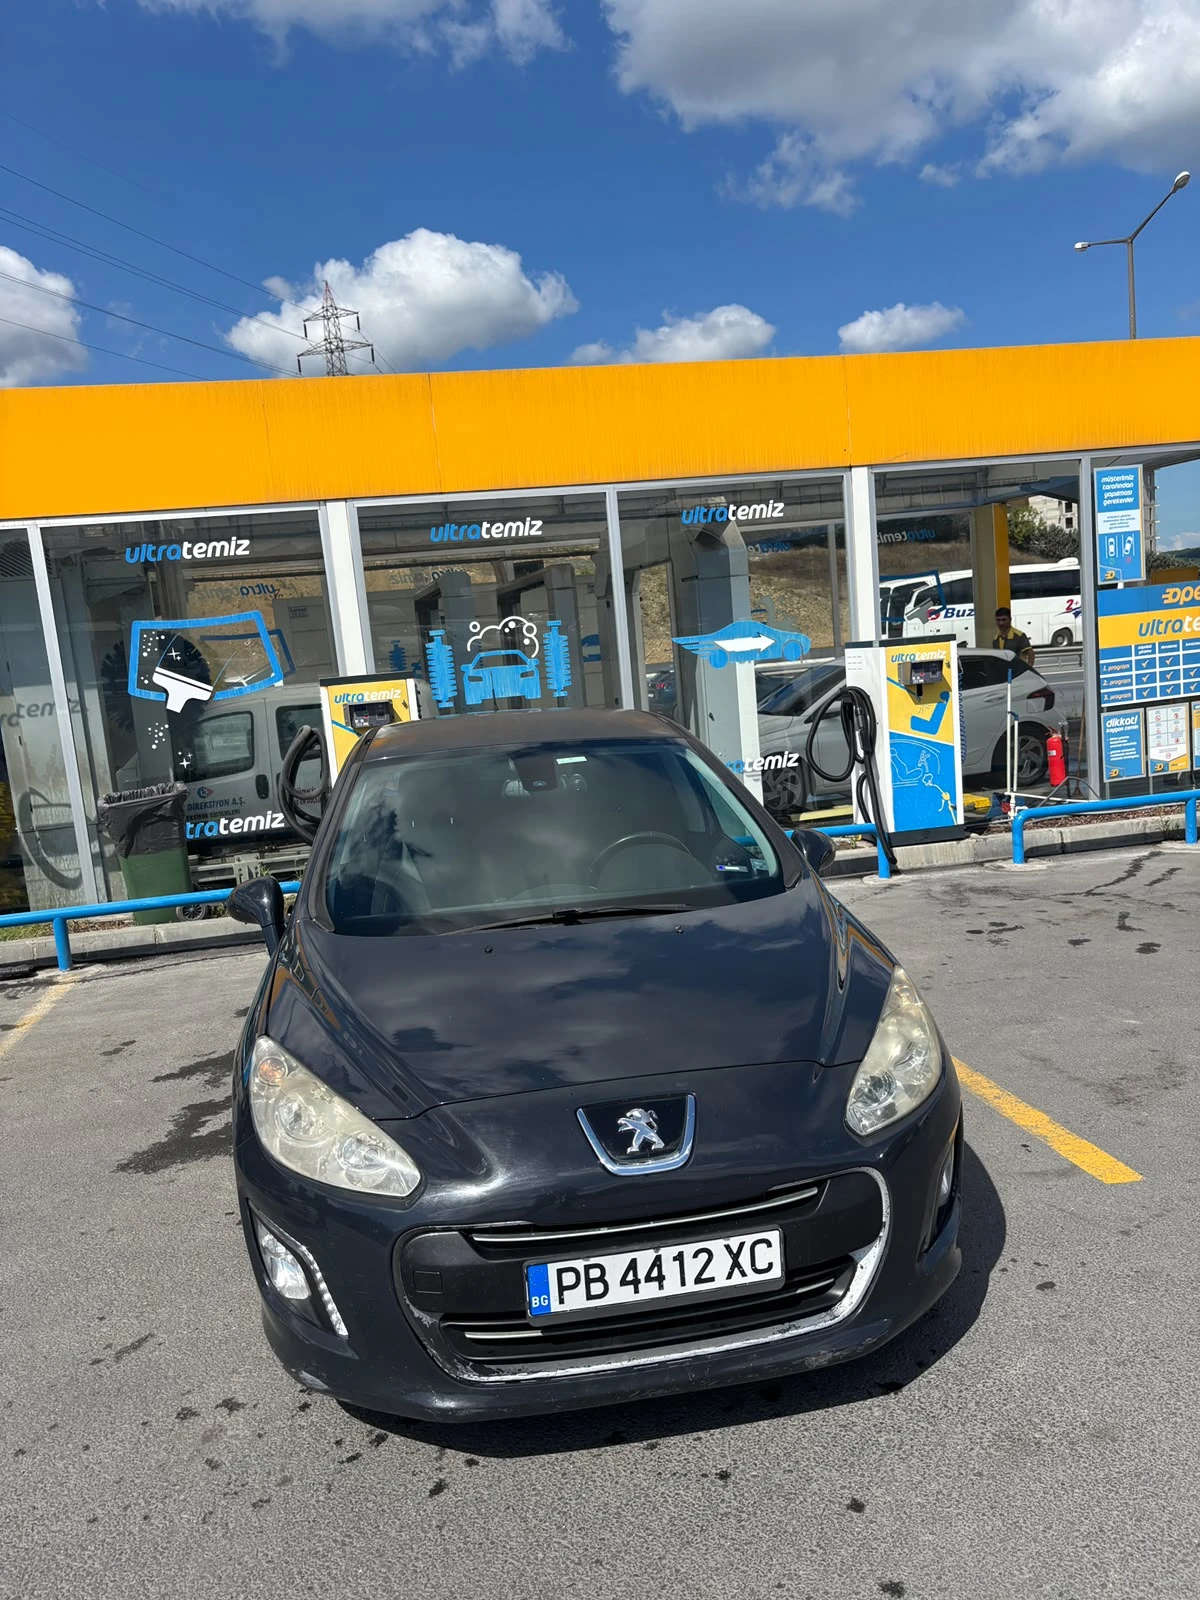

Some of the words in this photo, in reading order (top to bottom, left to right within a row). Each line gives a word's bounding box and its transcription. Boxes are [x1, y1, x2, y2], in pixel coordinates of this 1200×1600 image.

[681, 500, 784, 525] ultratemiz
[430, 517, 543, 542] ultratemiz
[125, 536, 250, 563] ultratemiz
[1162, 586, 1200, 605] ope
[1138, 616, 1200, 637] ultrate
[891, 649, 947, 663] ultratemiz
[334, 688, 401, 704] ultratemiz
[185, 811, 285, 839] tratemiz
[556, 1262, 609, 1304] PB
[619, 1247, 715, 1294] 4412
[724, 1237, 774, 1280] XC
[531, 1295, 548, 1308] BG
